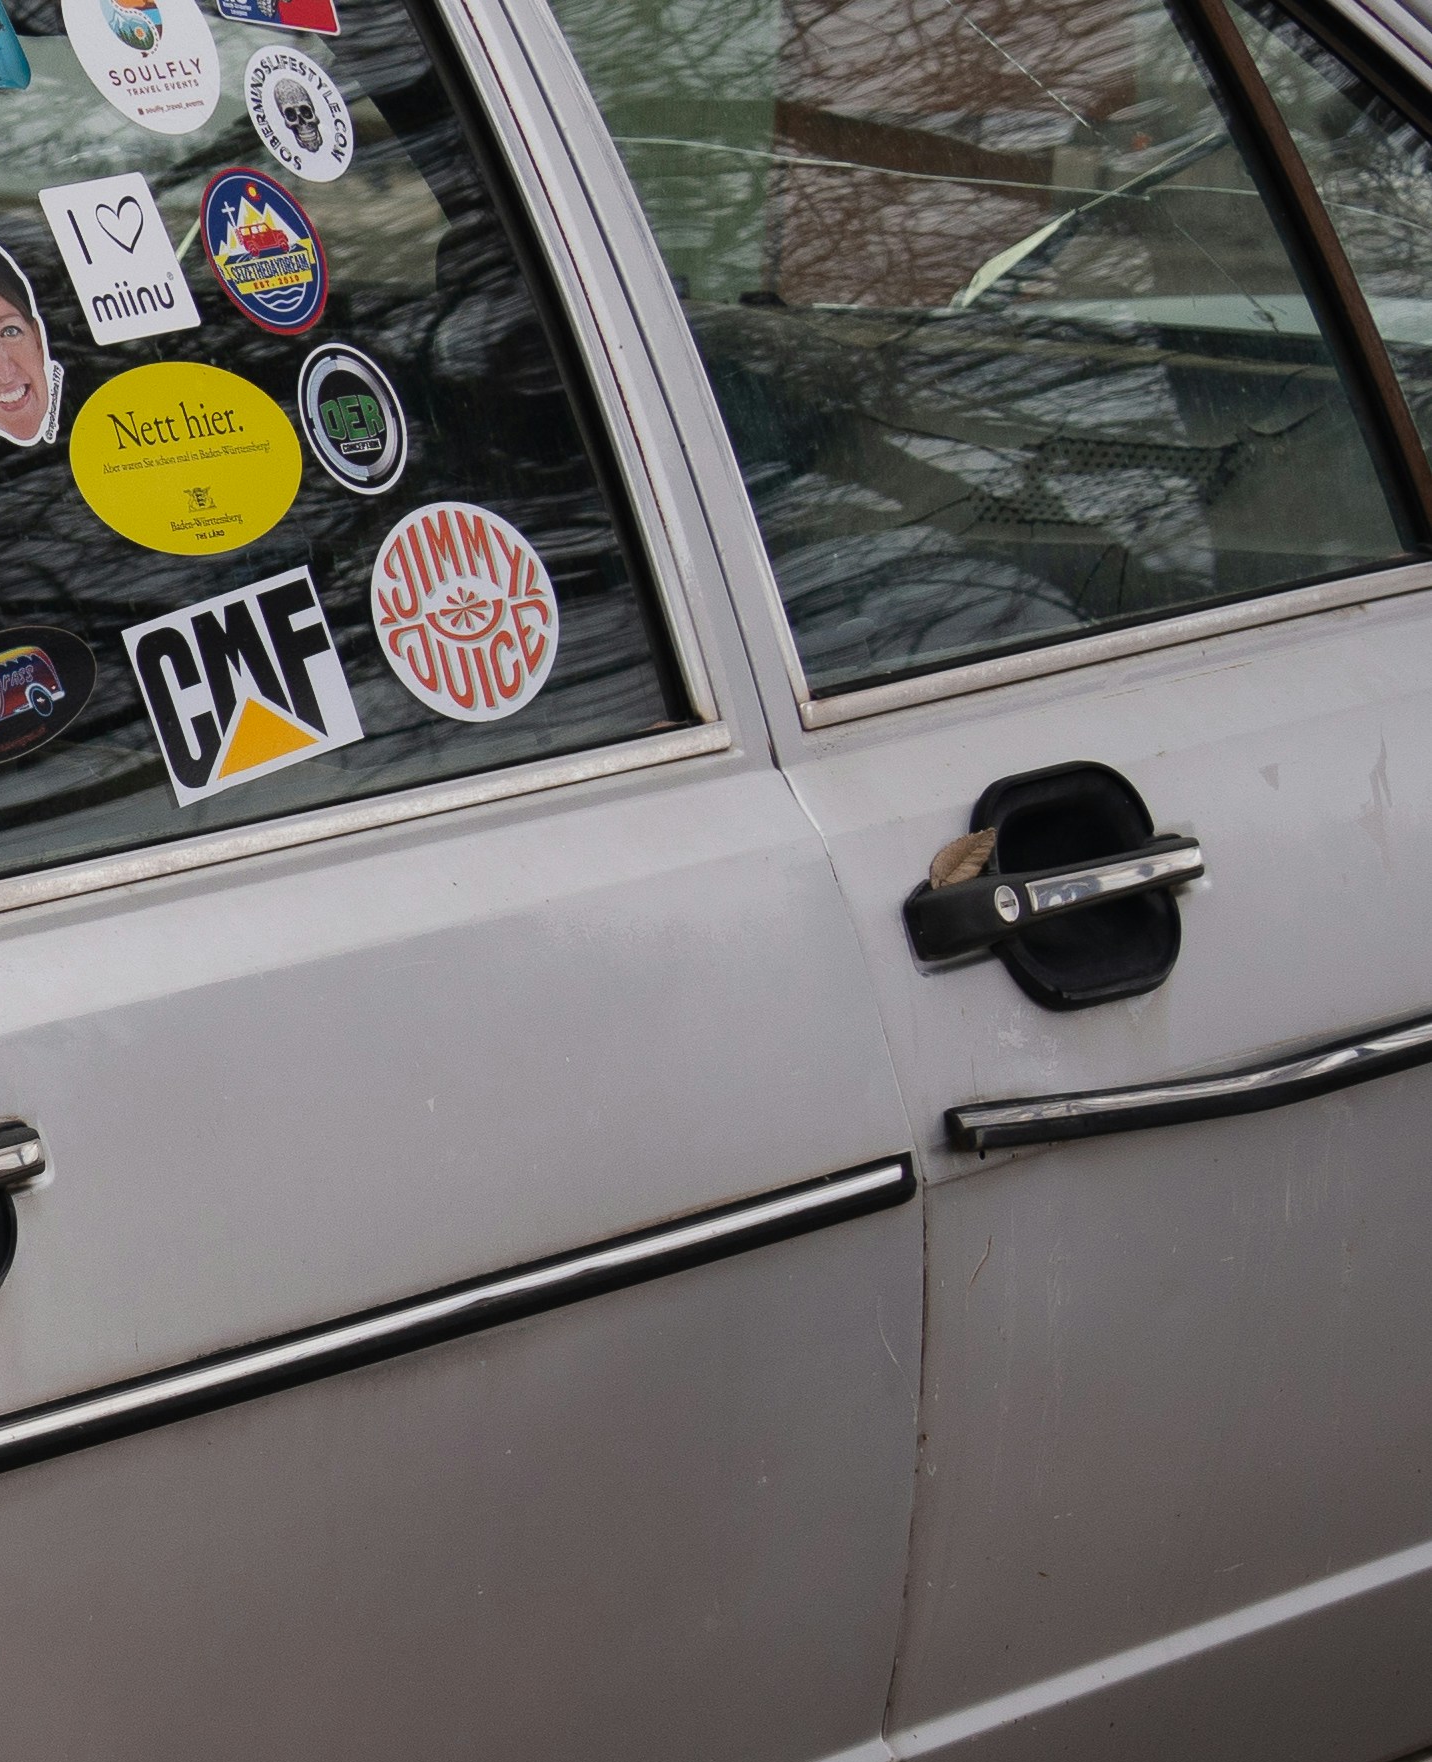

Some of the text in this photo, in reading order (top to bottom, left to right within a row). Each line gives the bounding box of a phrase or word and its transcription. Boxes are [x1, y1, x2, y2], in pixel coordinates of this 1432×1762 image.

[108, 57, 202, 87] SOULFLY
[126, 79, 200, 97] TRAVEL EVENTS
[66, 209, 93, 265] I
[253, 280, 275, 291] EST.
[107, 401, 244, 451] Nett hier.
[319, 394, 386, 441] DER
[383, 510, 523, 620] JIMMY
[388, 599, 550, 709] JUICE
[135, 577, 332, 789] CMF
